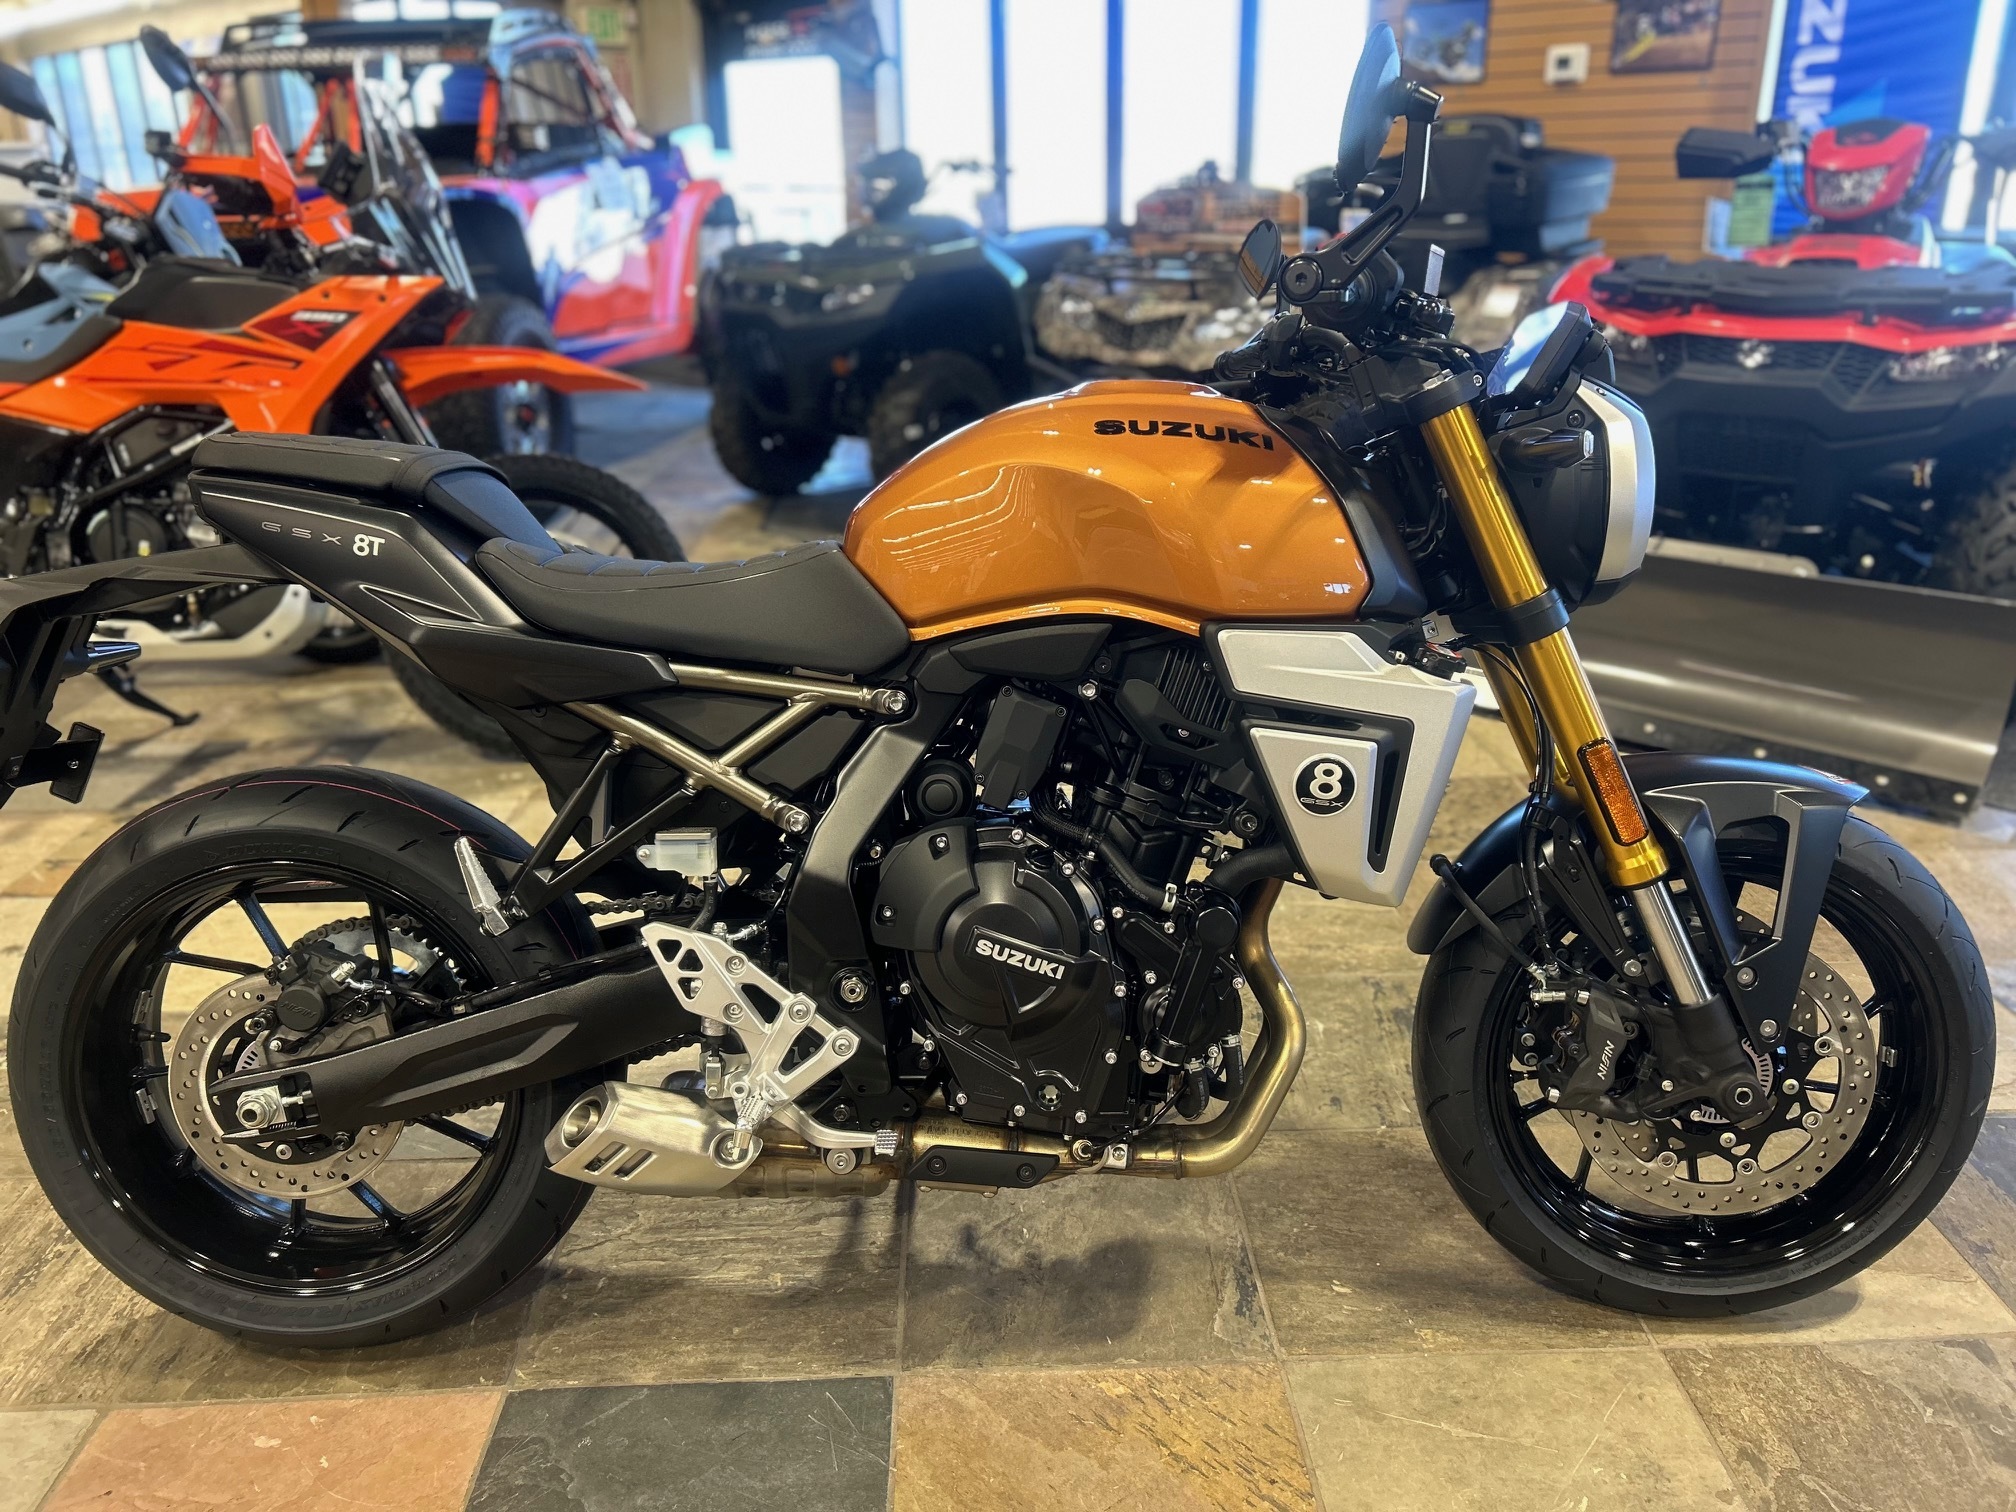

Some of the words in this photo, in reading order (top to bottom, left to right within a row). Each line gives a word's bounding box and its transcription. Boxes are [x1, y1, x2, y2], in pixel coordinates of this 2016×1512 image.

[1093, 419, 1275, 451] SUZUKI
[261, 521, 342, 546] GSX
[352, 533, 386, 557] 8T
[1309, 762, 1343, 800] 8
[1300, 797, 1345, 808] GSX
[975, 939, 1065, 980] SUZUKI
